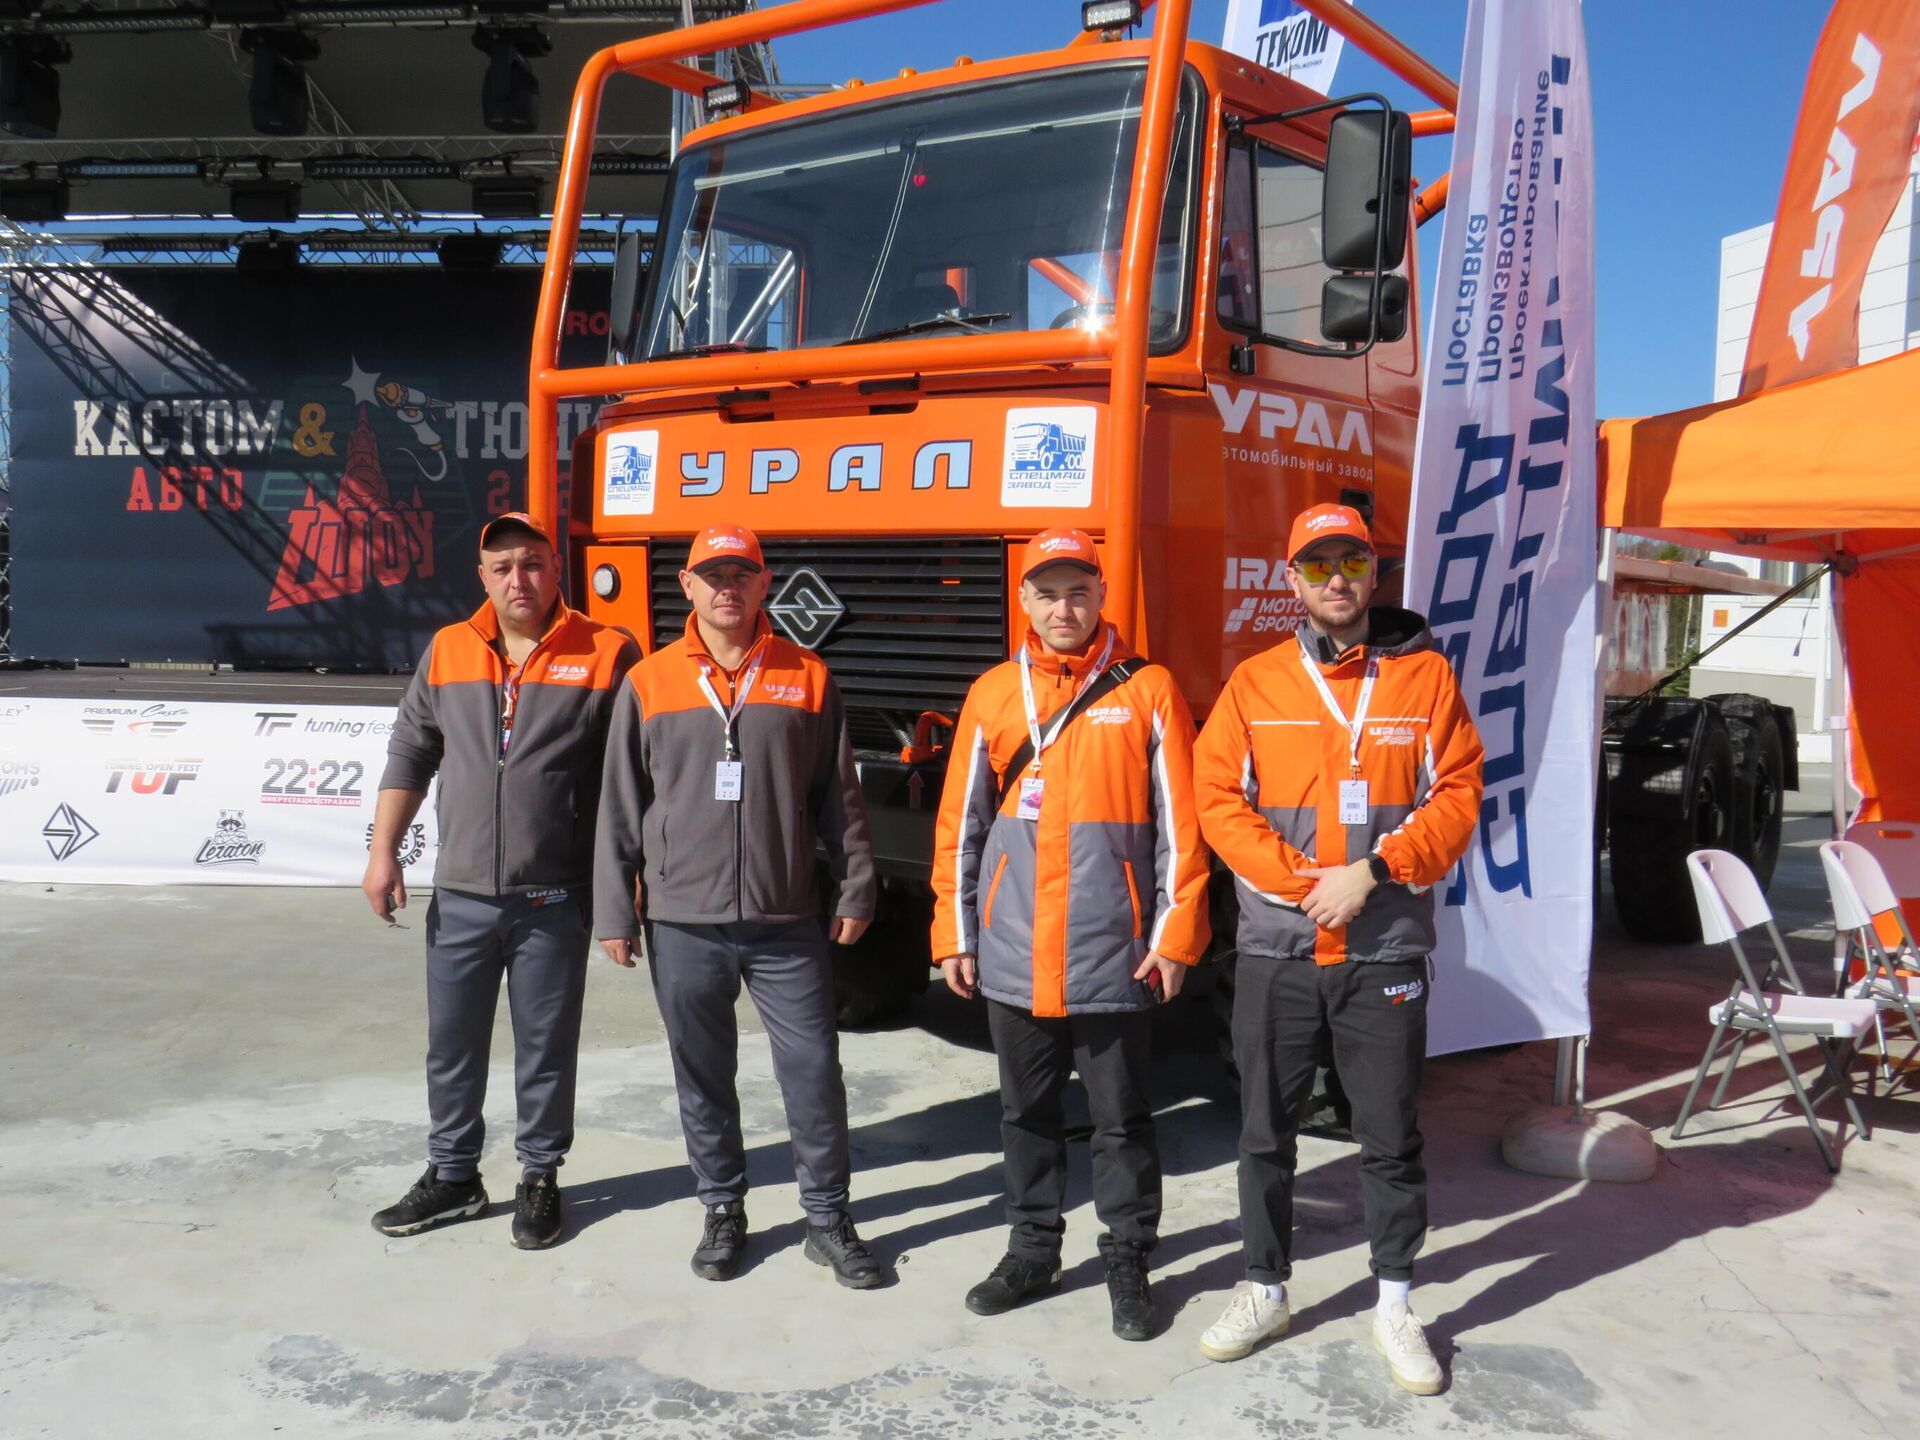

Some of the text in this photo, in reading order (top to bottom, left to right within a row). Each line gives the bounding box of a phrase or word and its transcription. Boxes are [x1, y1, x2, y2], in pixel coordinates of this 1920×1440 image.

[74, 400, 284, 456] КАСТОМ
[292, 402, 337, 457] &
[1208, 383, 1373, 456] УРАЛ
[680, 439, 973, 497] УРАЛ
[1009, 471, 1086, 481] СПЕЦМАШ
[1338, 463, 1374, 482] завод
[126, 466, 243, 512] АВТО
[1007, 481, 1051, 490] ЗАВОД
[1259, 598, 1308, 613] MOTO
[83, 707, 139, 715] PREMIUM
[261, 758, 364, 796] 22:22
